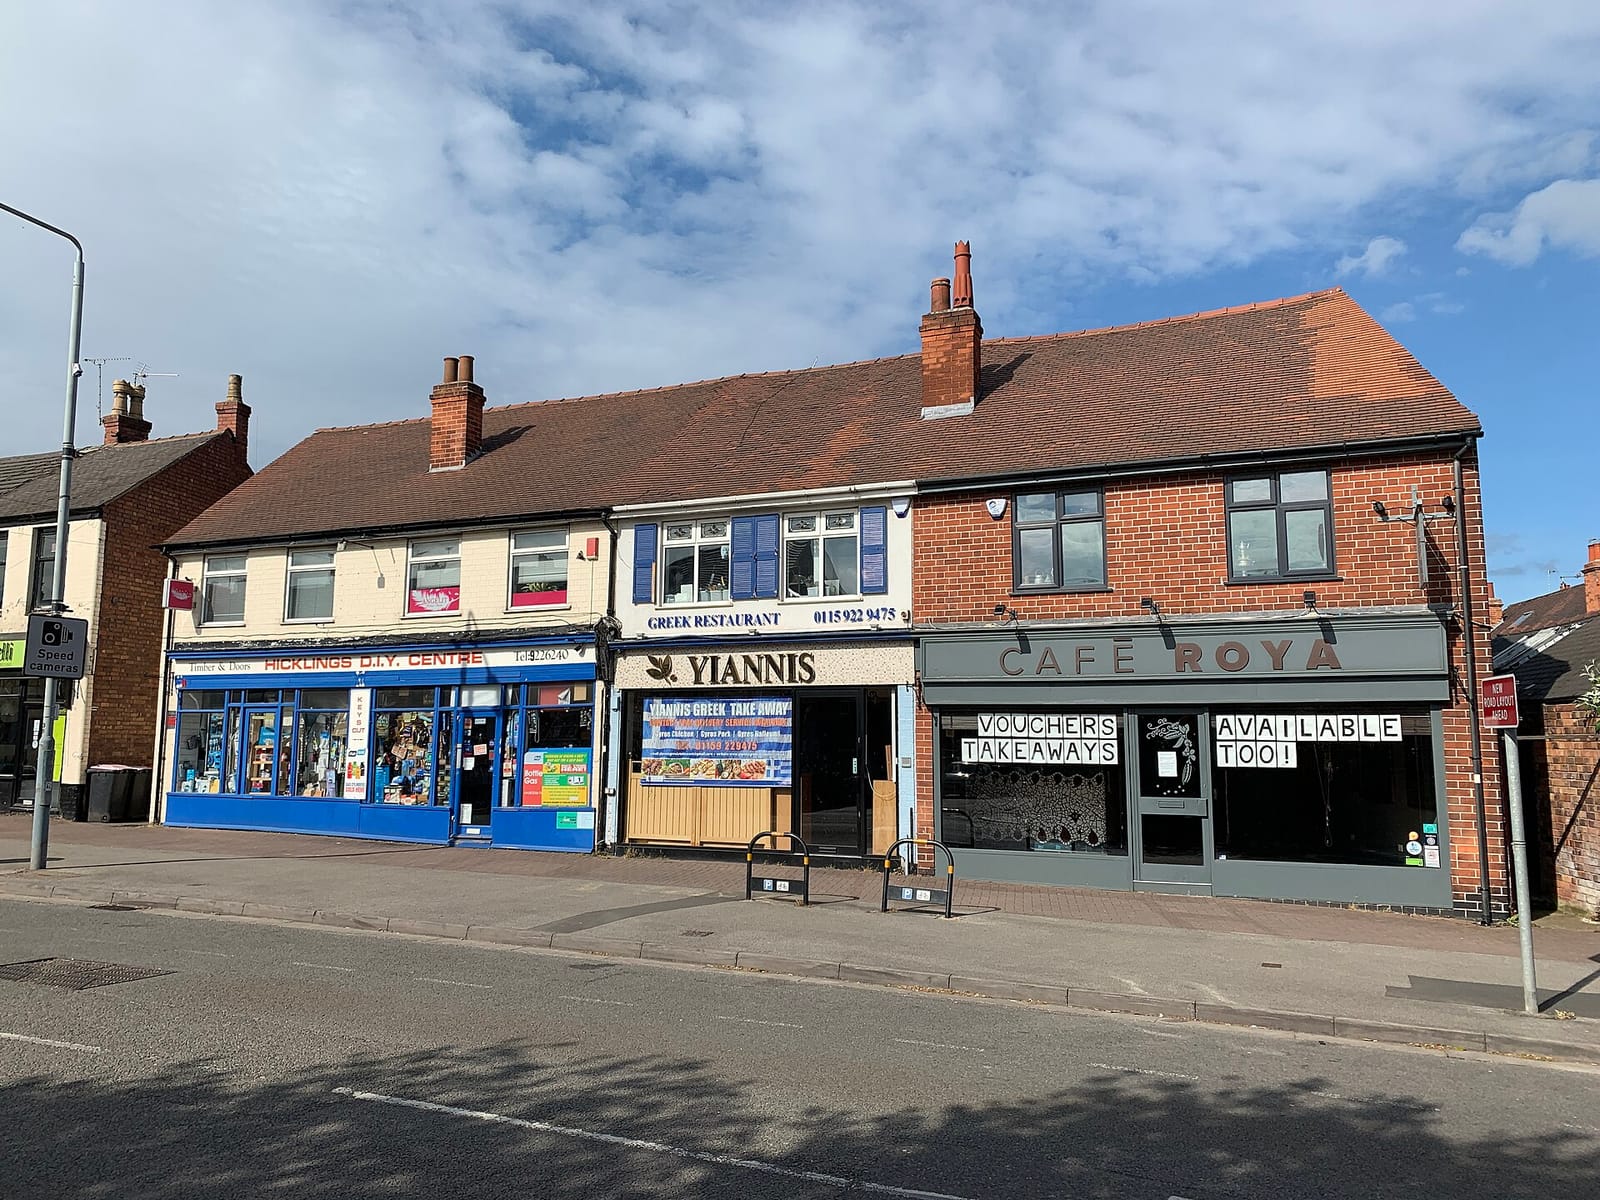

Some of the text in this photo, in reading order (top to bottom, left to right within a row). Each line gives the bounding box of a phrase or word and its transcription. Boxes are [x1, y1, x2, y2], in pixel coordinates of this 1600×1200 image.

[647, 616, 692, 630] GREEK
[694, 612, 781, 628] RESTAURANT
[842, 608, 864, 622] 922
[866, 607, 896, 621] 9475
[37, 649, 74, 661] Speed
[264, 651, 483, 671] HICKLINGS D.I.Y. CENTRE
[1175, 638, 1343, 673] ROYA
[30, 662, 79, 673] cameras
[189, 660, 251, 672] Timber & Doors
[687, 652, 816, 685] YIANNIS
[649, 701, 789, 717] YIANNIS GREEK TAKE AWAY
[1484, 696, 1514, 707] ROAD LAYOUT
[979, 716, 1115, 736] VOUCHERS
[1218, 718, 1398, 737] AVAILABLE
[963, 741, 1116, 761] TAKEAWAYS
[1218, 744, 1290, 764] TOO!
[524, 769, 543, 777] Bottle
[524, 777, 538, 785] Gas
